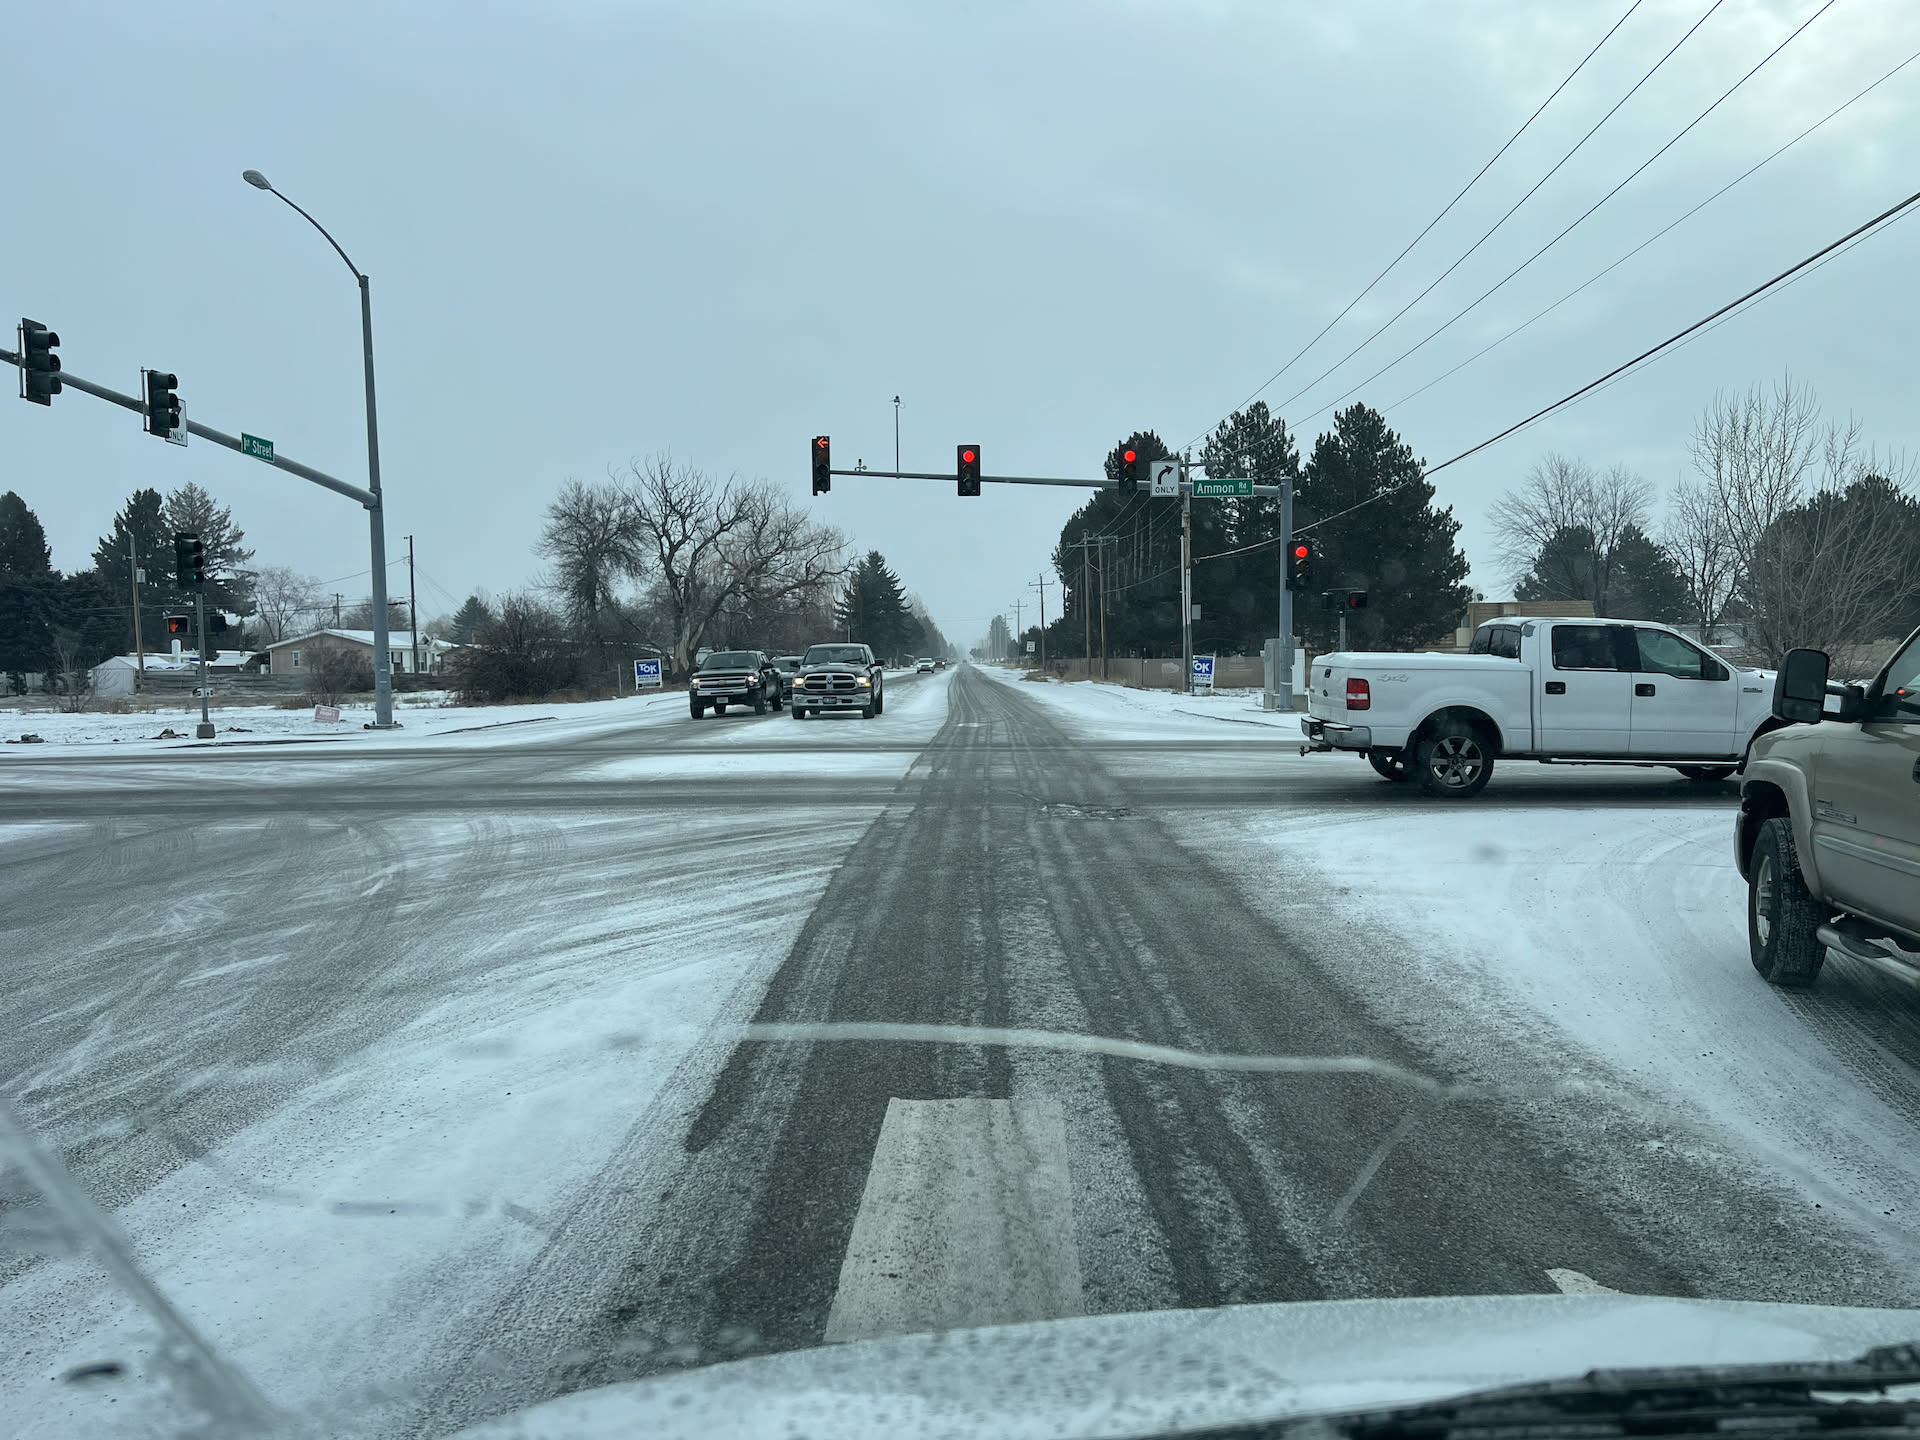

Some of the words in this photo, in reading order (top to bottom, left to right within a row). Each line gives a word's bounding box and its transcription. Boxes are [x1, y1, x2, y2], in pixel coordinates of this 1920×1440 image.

[252, 440, 273, 458] Street
[1155, 486, 1175, 494] ONLY
[1197, 482, 1234, 494] Ammon
[1238, 481, 1247, 489] Rd
[638, 663, 657, 674] TOK
